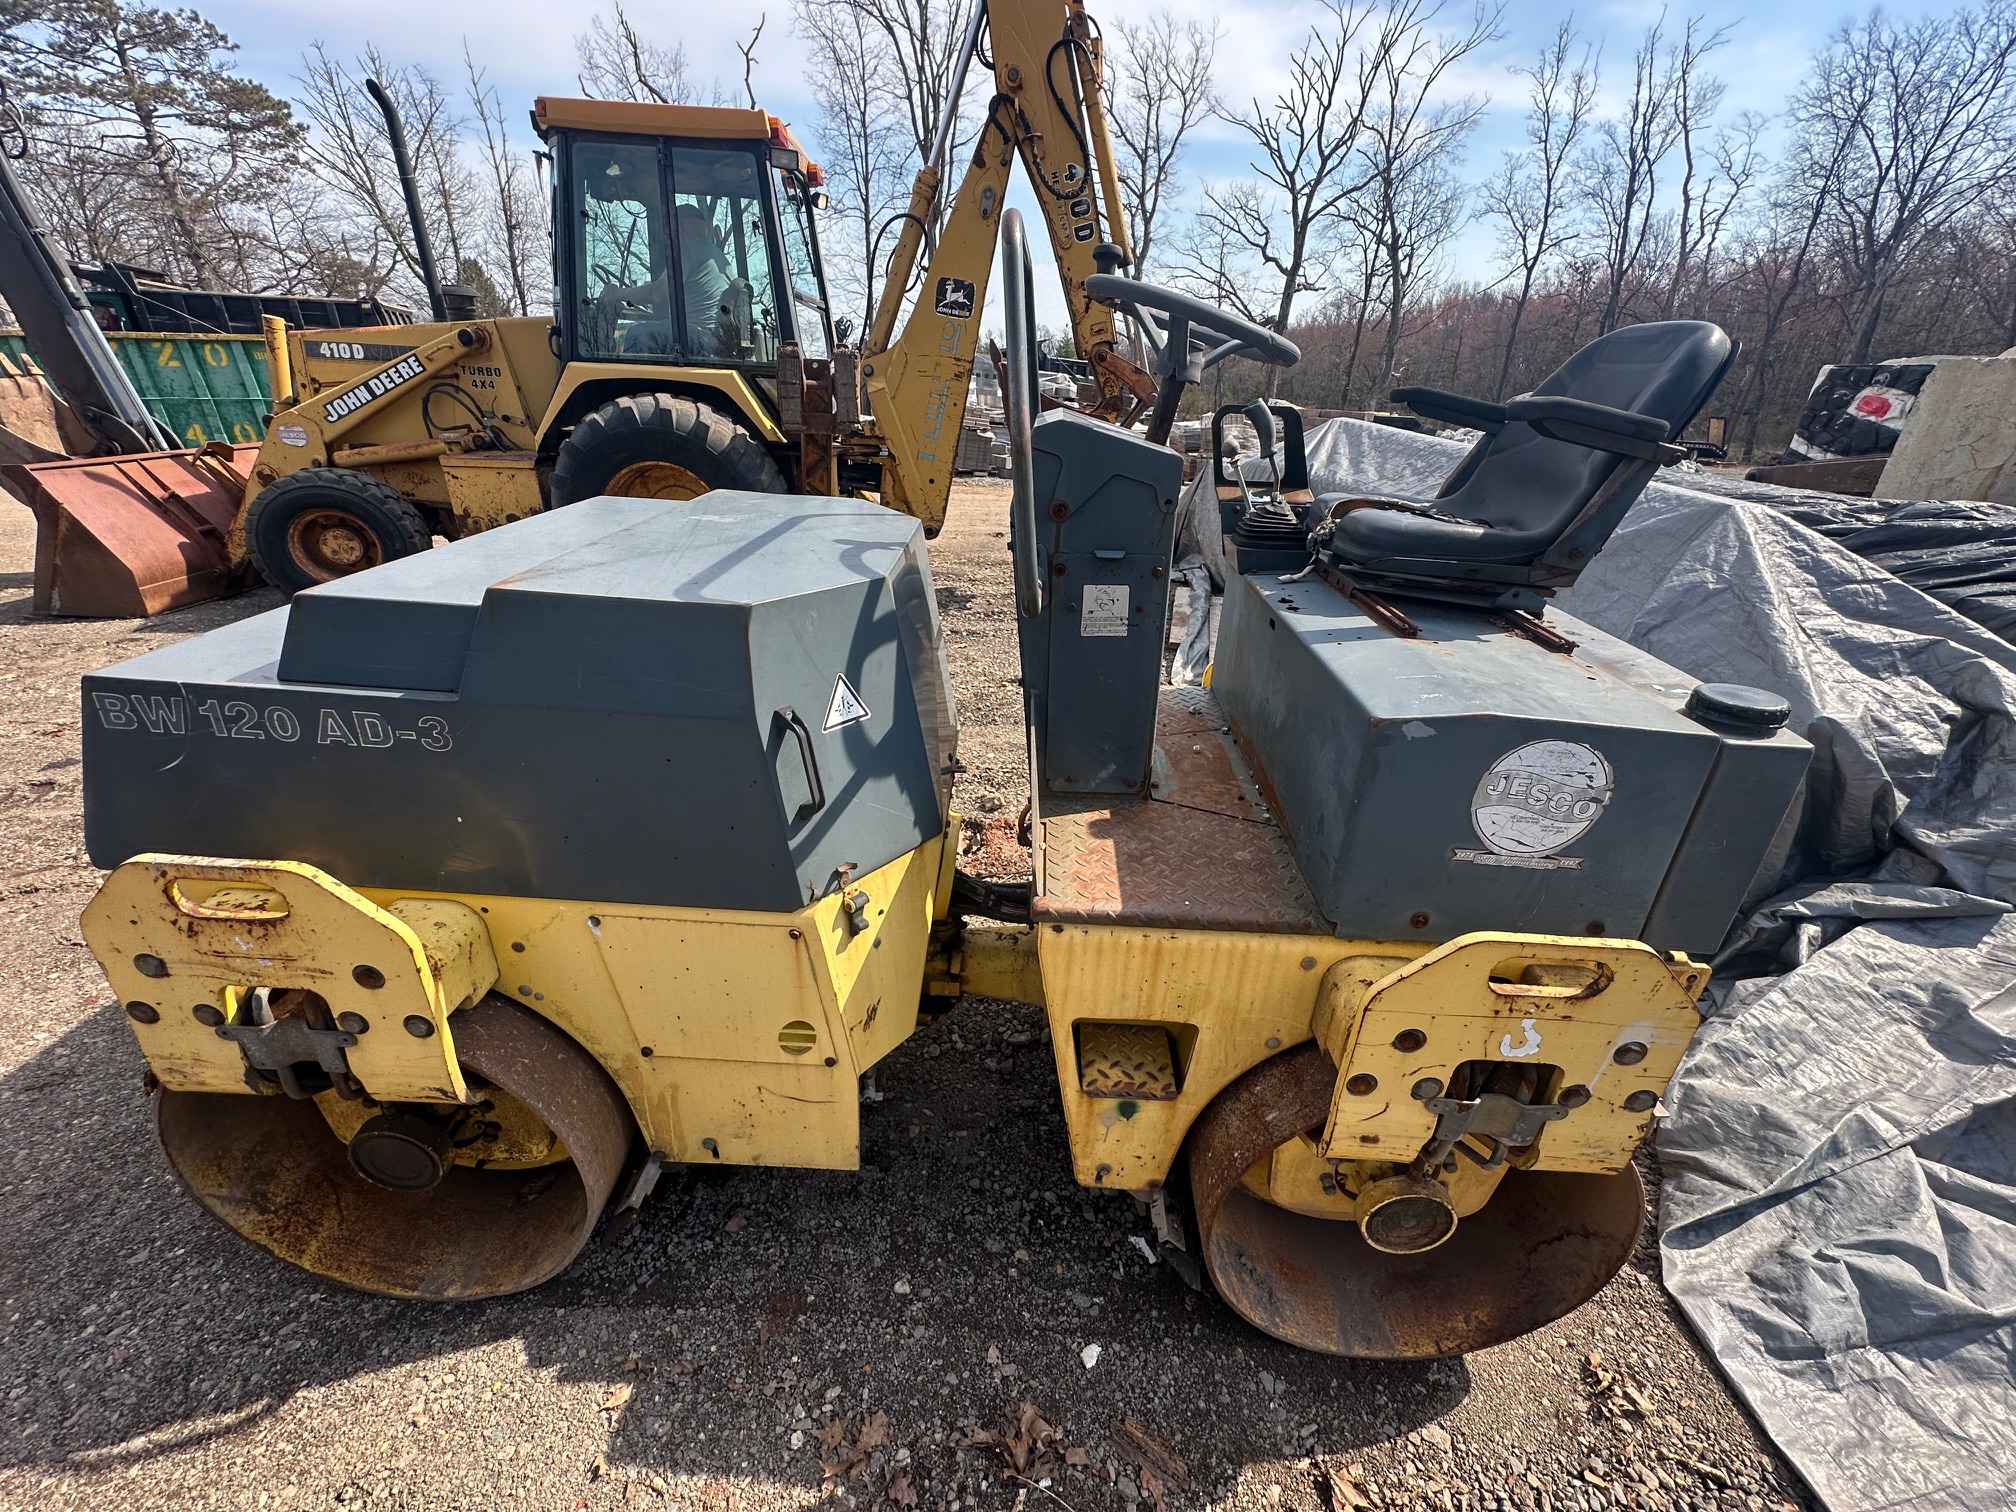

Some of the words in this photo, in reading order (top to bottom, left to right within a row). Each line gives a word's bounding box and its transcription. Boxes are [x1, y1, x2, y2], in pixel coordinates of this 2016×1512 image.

[952, 309, 970, 317] DEE
[459, 365, 501, 378] TURBO
[471, 379, 496, 391] 4X4
[326, 385, 372, 422] JOHN
[368, 355, 425, 399] DEERE
[92, 691, 186, 735] BW
[198, 699, 301, 742] 120
[317, 708, 453, 752] AD-3
[1486, 773, 1598, 820] JESCO
